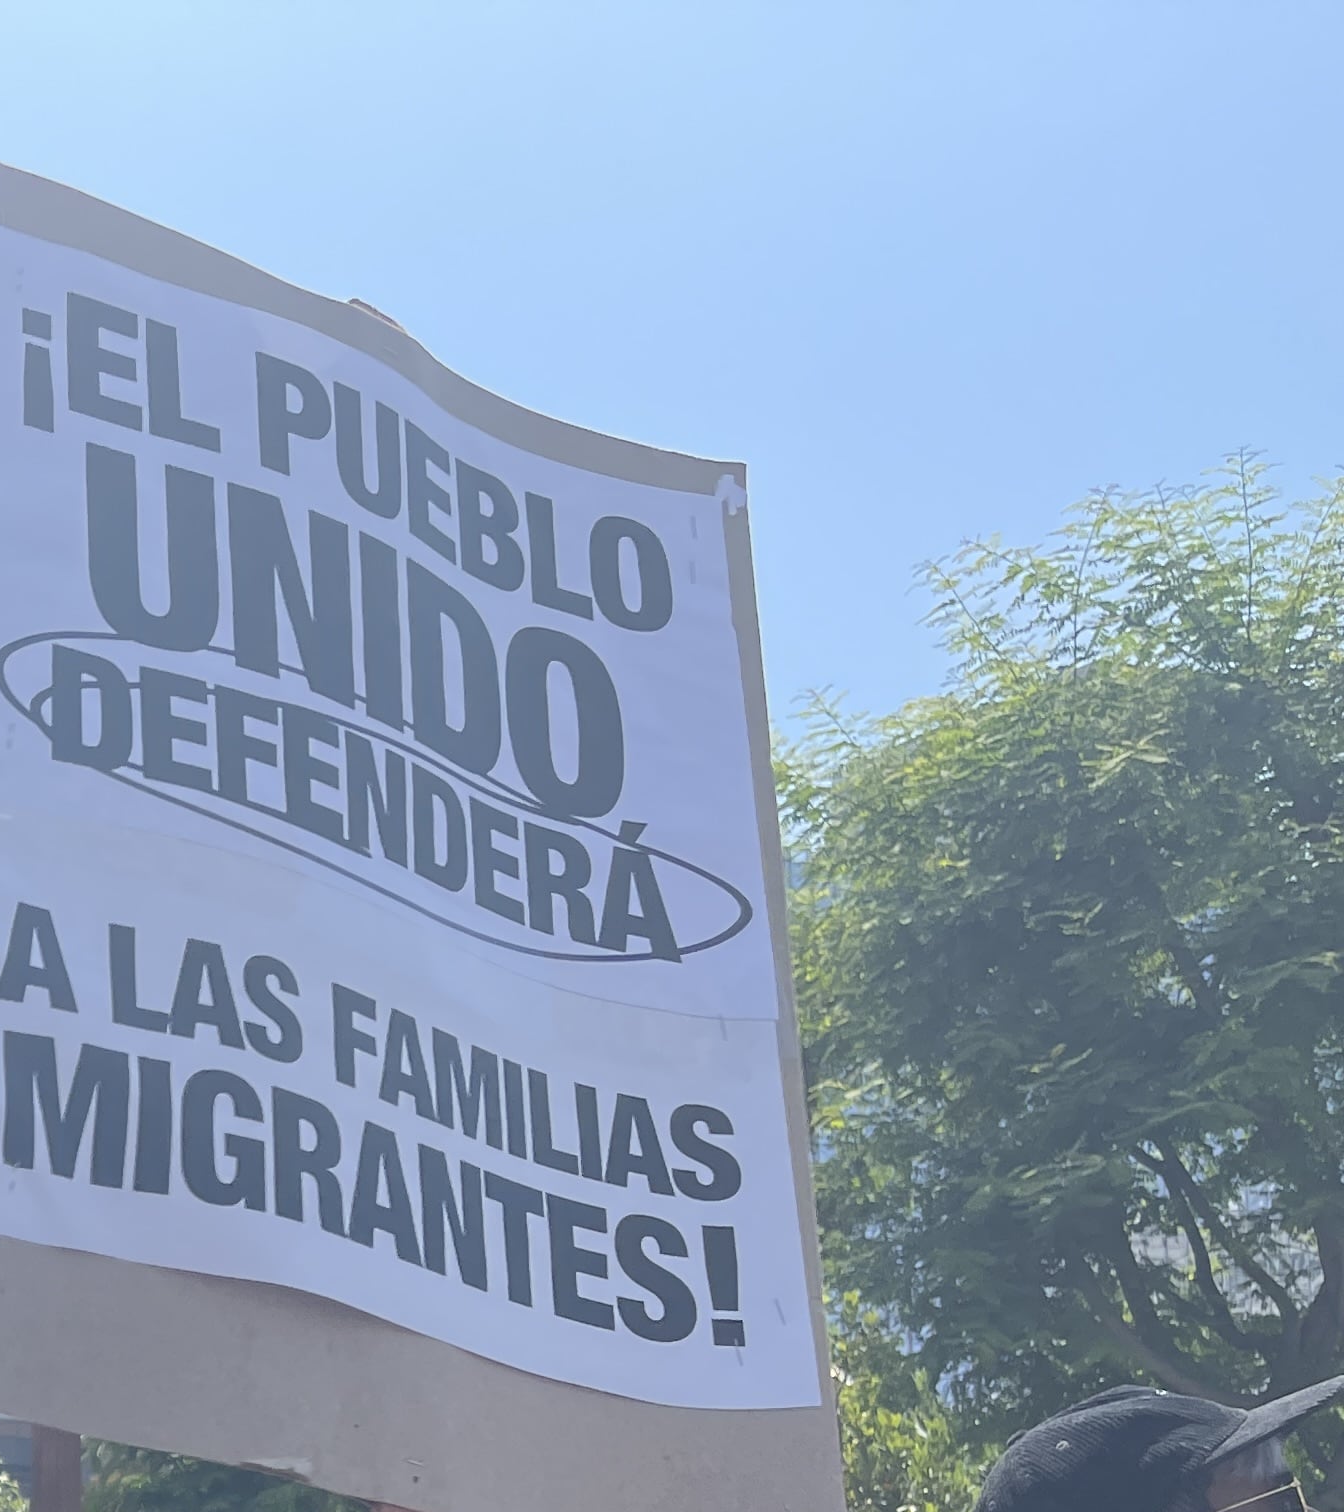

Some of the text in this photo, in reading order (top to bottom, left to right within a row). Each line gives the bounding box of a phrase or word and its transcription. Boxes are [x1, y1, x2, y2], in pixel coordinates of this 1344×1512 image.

[22, 292, 673, 632] ¡EL PUEBLO
[86, 441, 625, 818] UNIDO
[51, 644, 682, 963] DEFENDERÁ
[2, 1030, 746, 1347] MIGRANTES!
[108, 924, 303, 1063] LAS
[331, 983, 742, 1202] FAMILIAS
